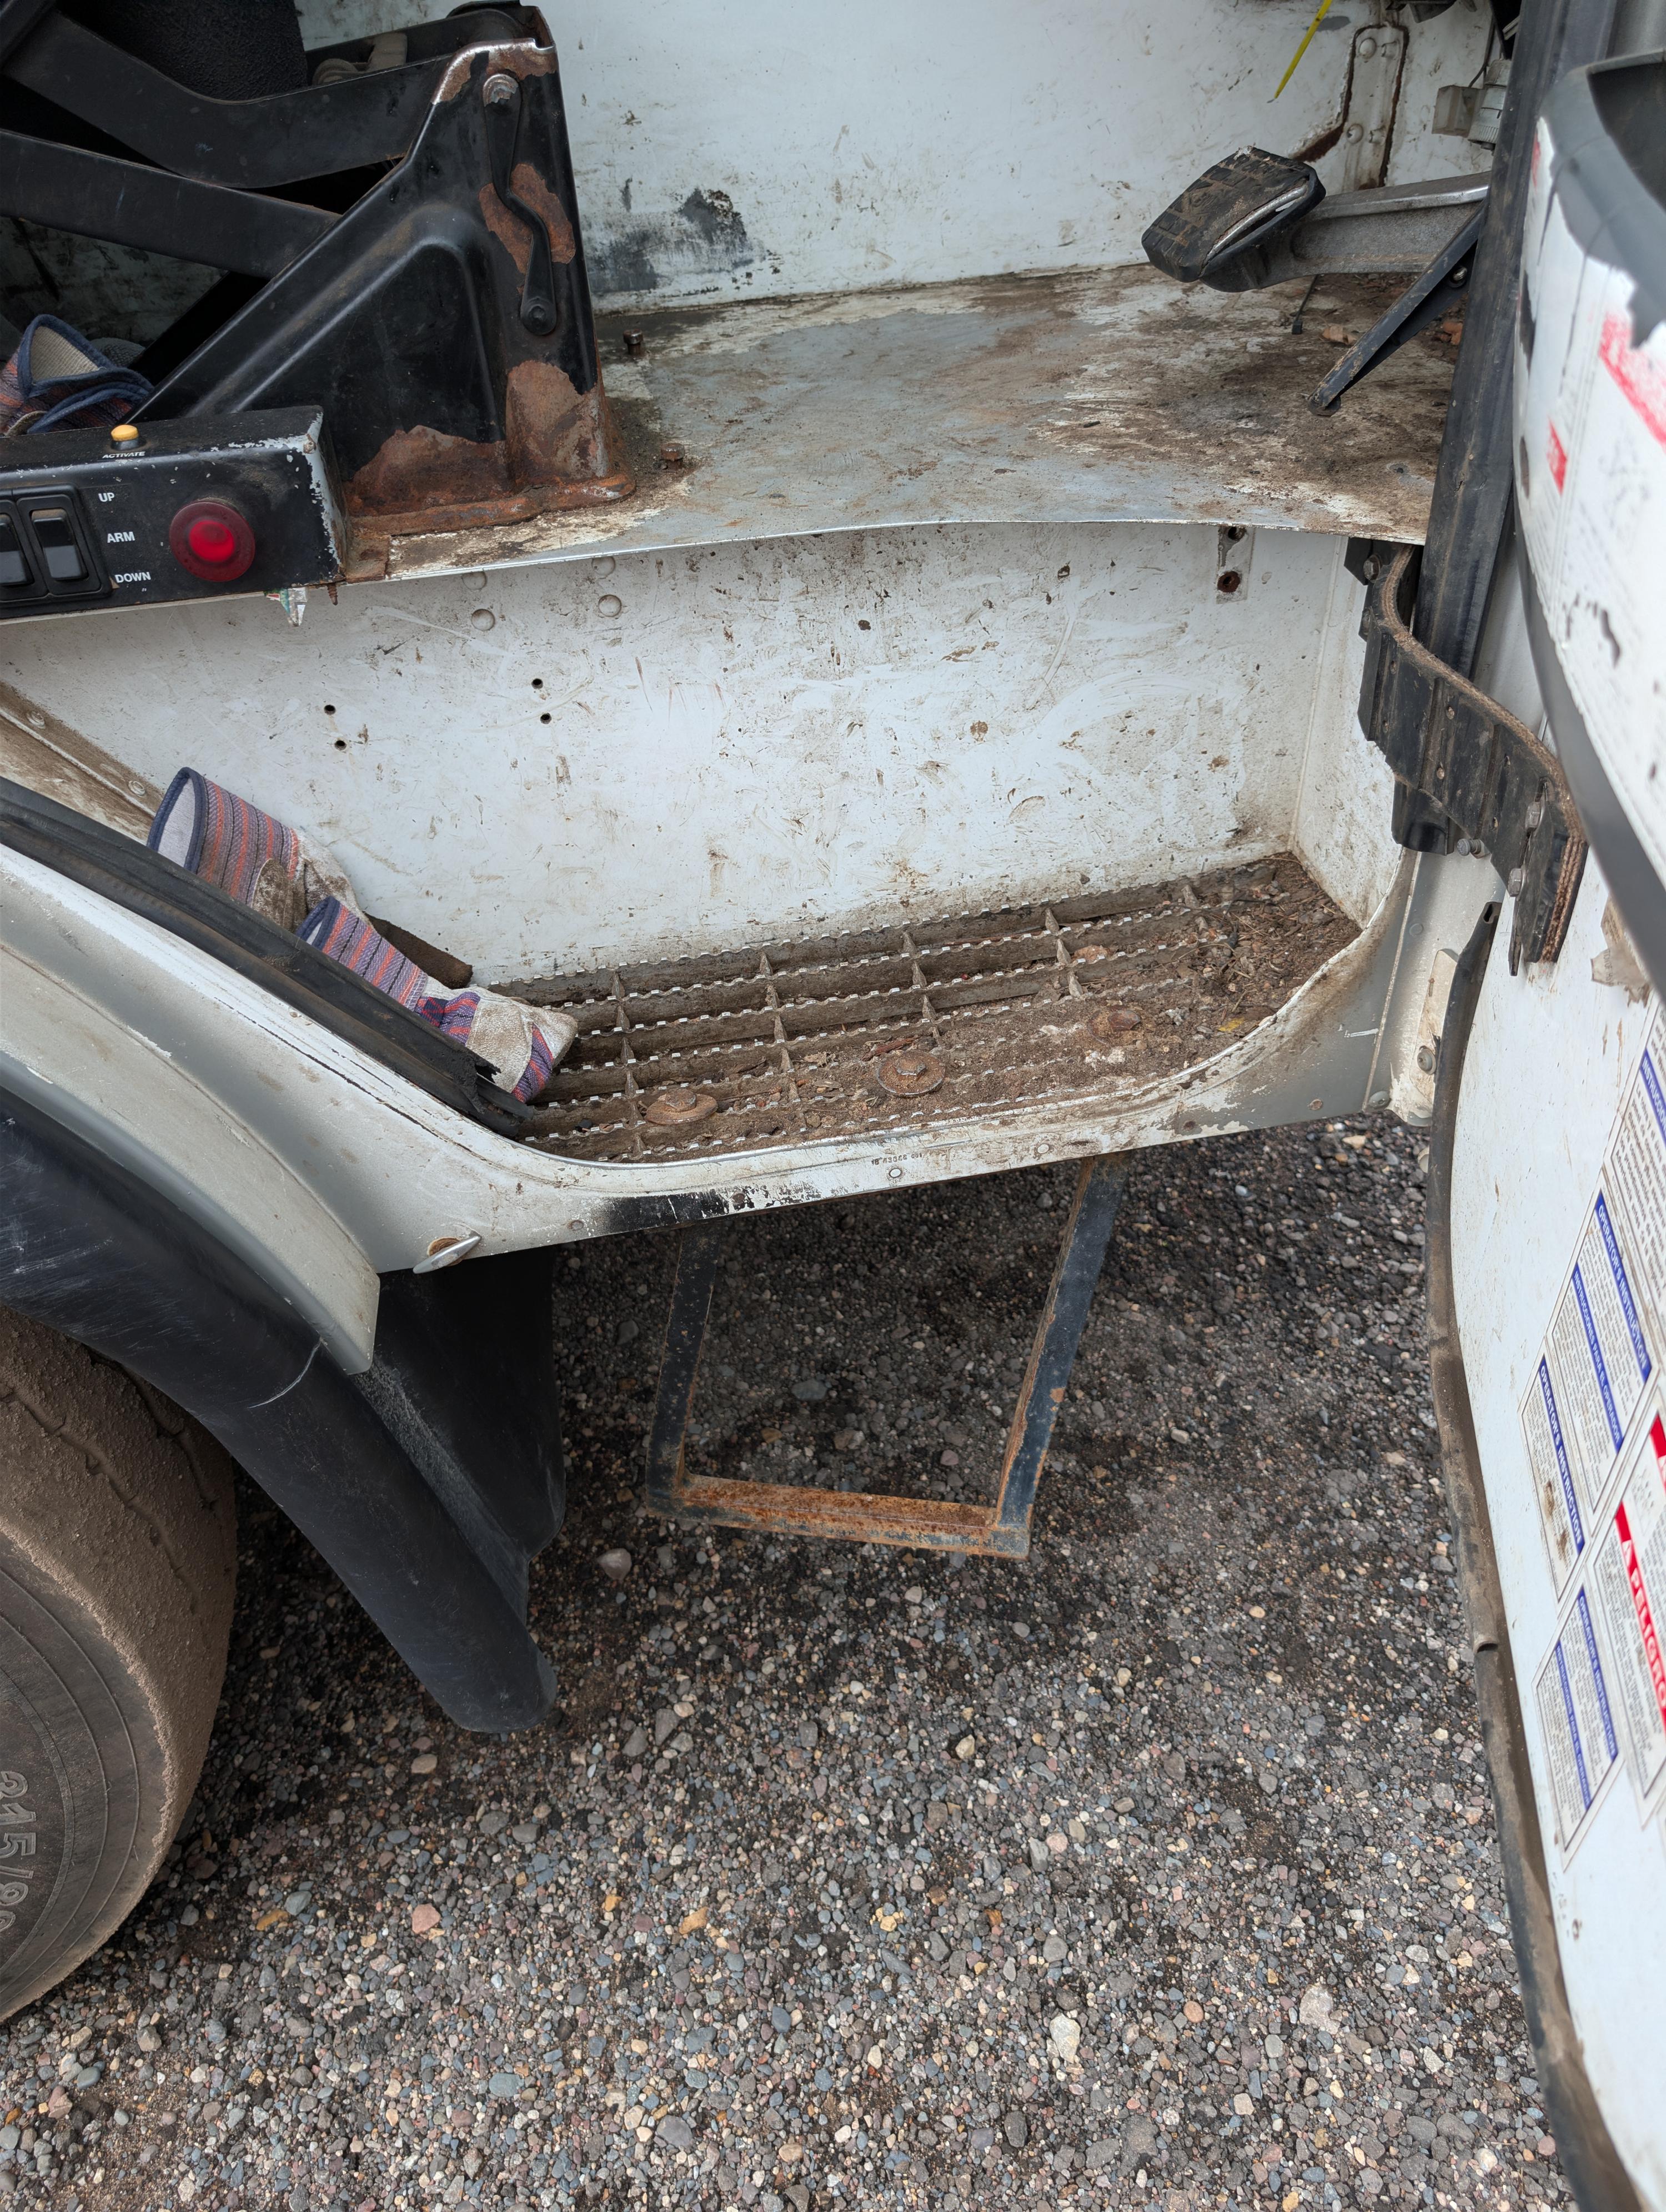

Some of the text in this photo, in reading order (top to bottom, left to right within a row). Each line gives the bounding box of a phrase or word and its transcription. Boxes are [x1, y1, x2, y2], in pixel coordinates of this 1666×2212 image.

[98, 492, 115, 502] UP
[107, 531, 136, 543] ARM
[114, 571, 151, 584] DOWN
[1574, 1269, 1620, 1445] INSTRUCCIONES PARA EL OPERADOR
[1598, 1200, 1622, 1284] OPERATOR'S
[1619, 1275, 1647, 1373] INSTRUCTION
[1540, 1361, 1560, 1449] OPERATOR'S
[1558, 1444, 1581, 1546] INSTRUCTION
[1630, 1566, 1666, 1707] PELIGRO
